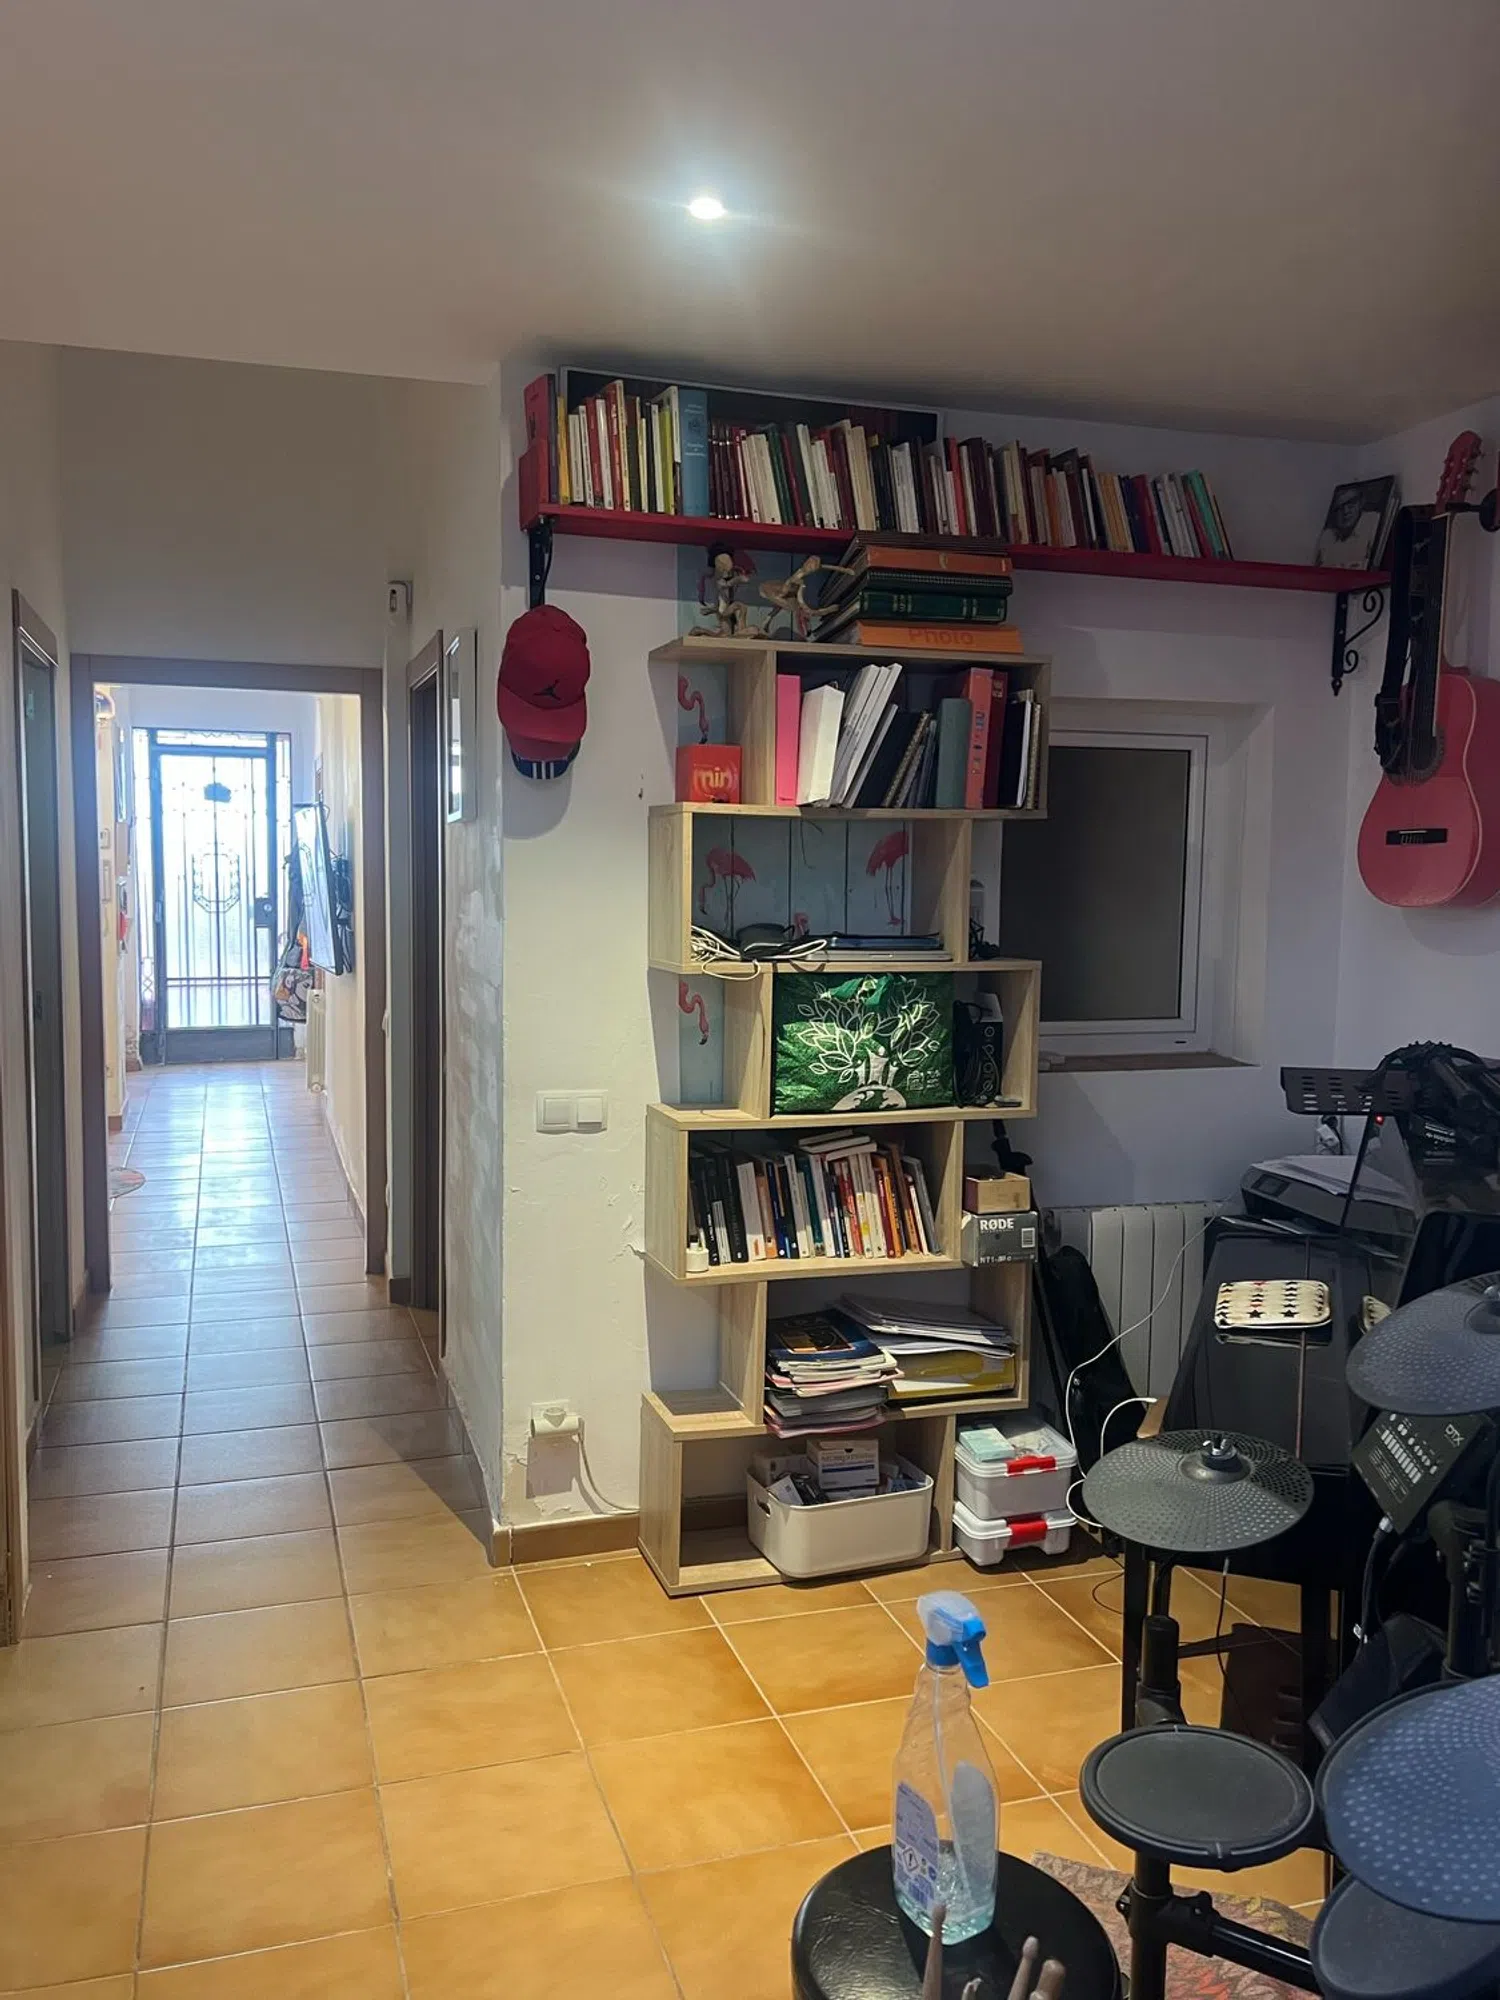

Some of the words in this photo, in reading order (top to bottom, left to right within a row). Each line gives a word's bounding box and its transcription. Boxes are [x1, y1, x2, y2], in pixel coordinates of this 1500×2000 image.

[908, 626, 975, 646] Photo
[980, 1217, 1015, 1231] RØDE
[1445, 1423, 1465, 1447] DTX
